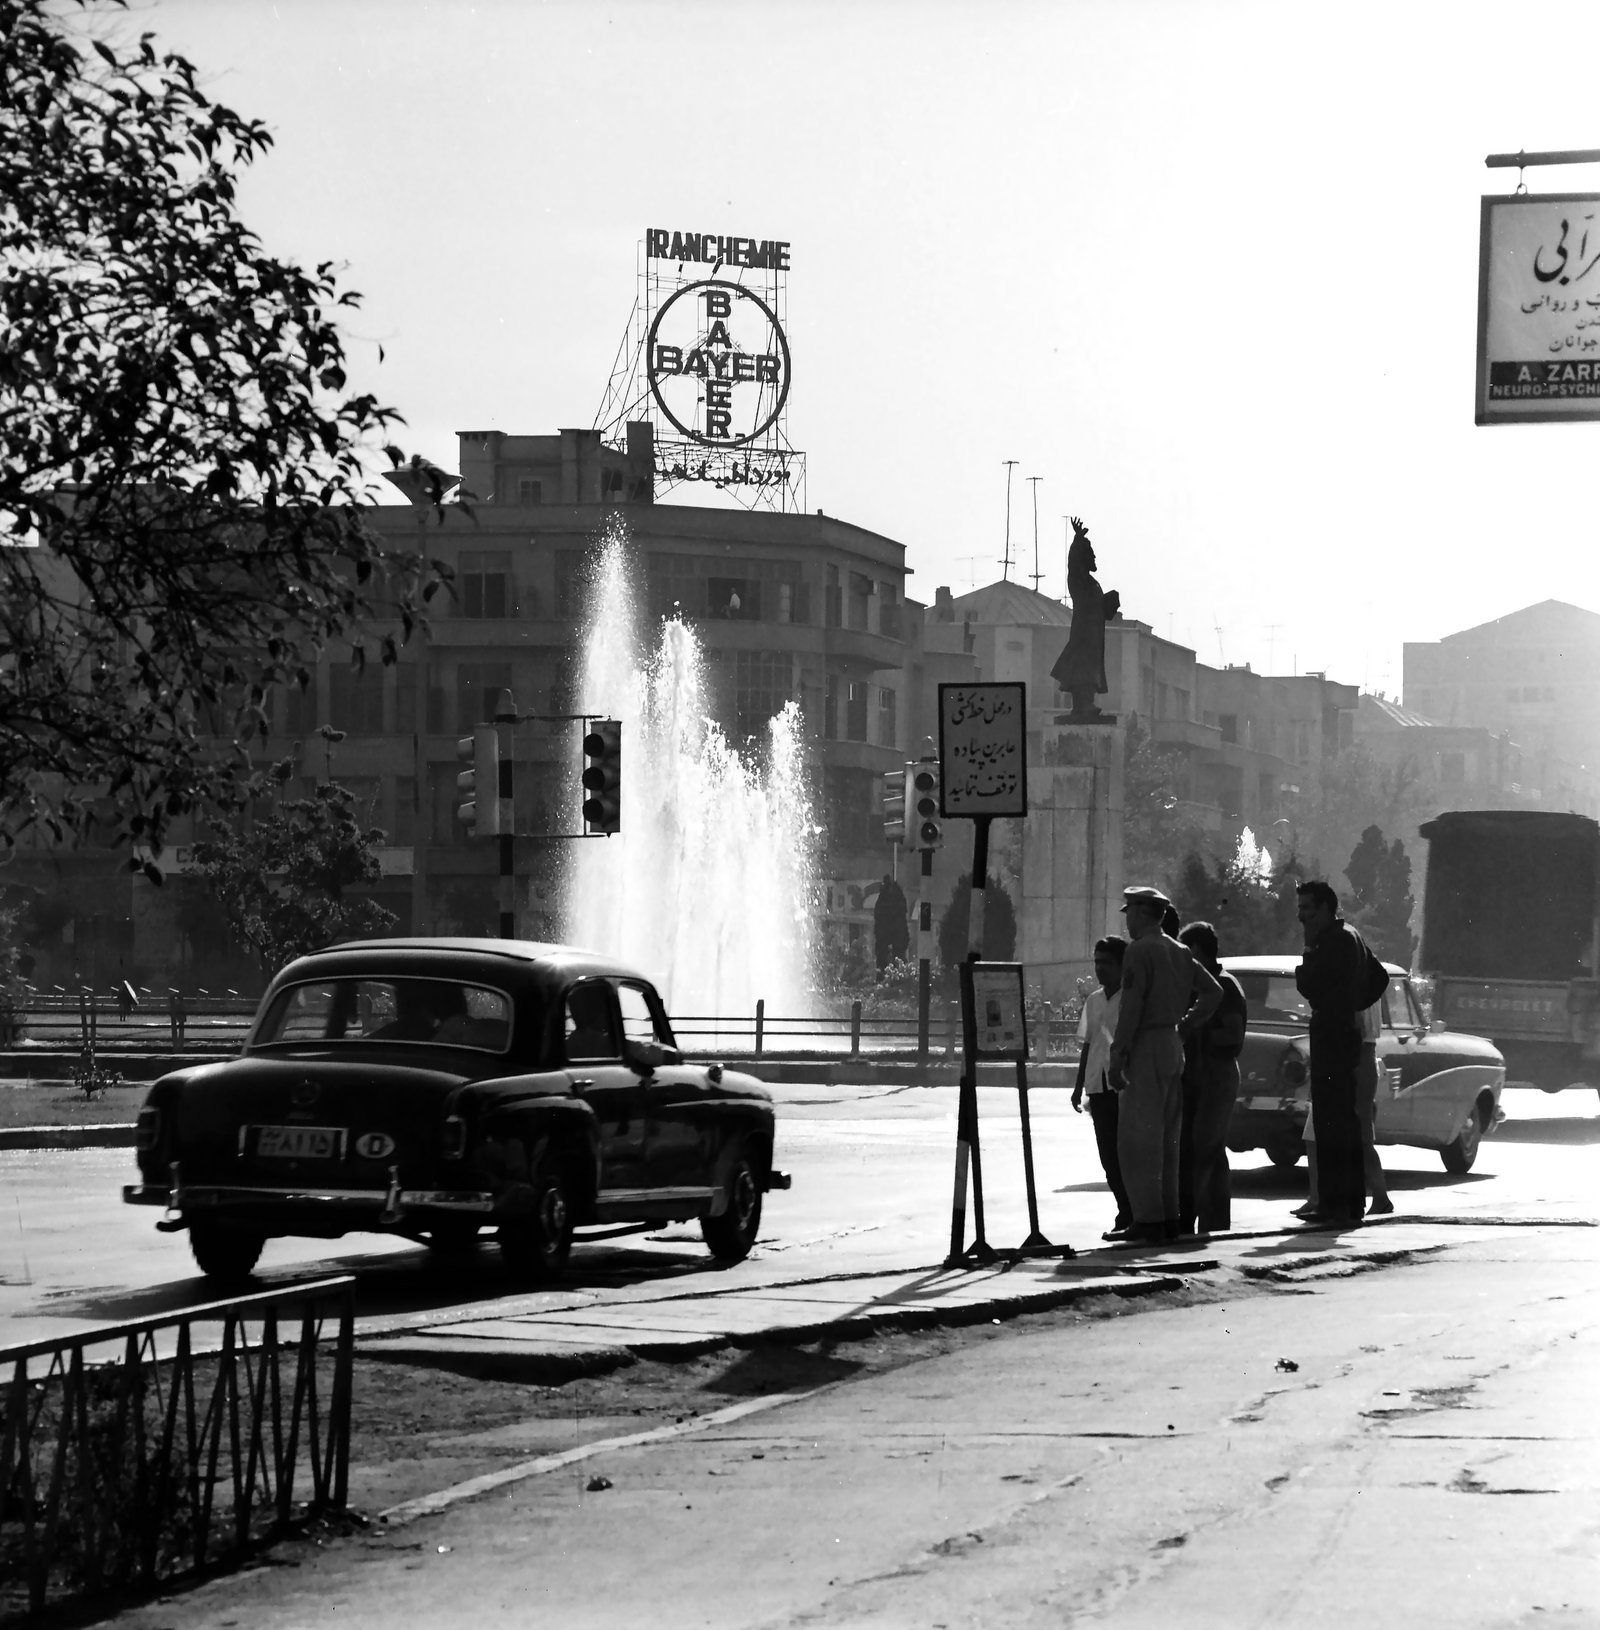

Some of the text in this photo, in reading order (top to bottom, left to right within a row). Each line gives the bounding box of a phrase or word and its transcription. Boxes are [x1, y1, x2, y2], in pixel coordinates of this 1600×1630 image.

[647, 228, 791, 271] IRANCHEMIE
[656, 345, 781, 384] BAYER
[706, 289, 732, 439] BAYER
[1517, 364, 1538, 383] A.
[954, 738, 1016, 771] عابرین پیاده
[976, 774, 1017, 798] توقف
